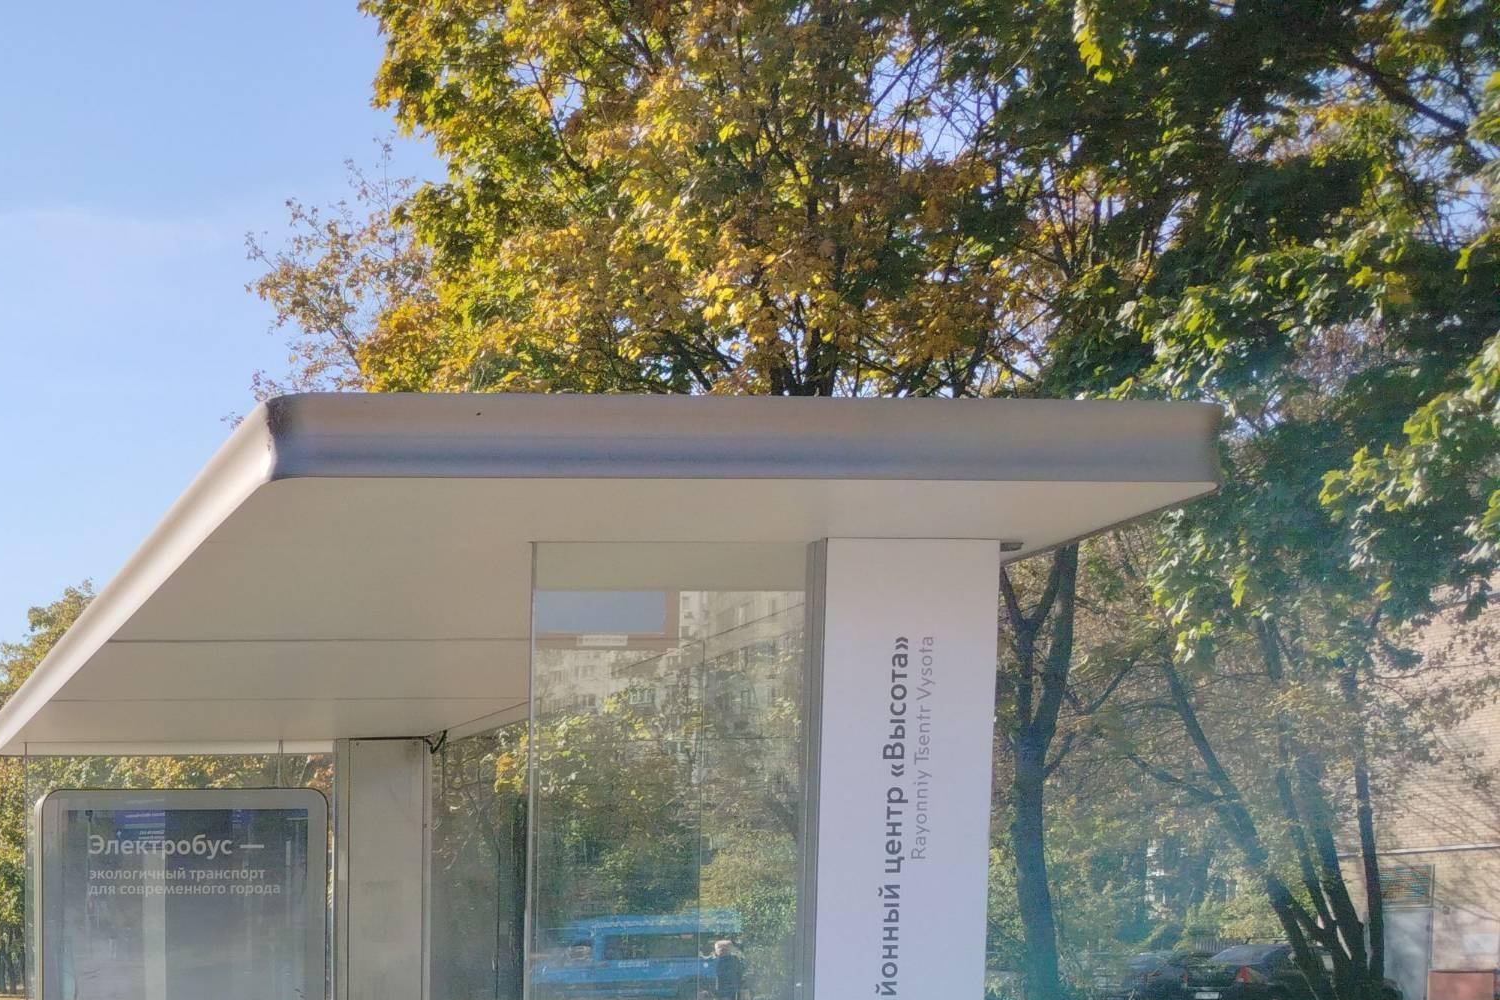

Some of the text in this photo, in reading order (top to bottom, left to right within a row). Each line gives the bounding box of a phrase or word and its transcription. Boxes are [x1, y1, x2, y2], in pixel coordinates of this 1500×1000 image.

[882, 636, 910, 778] «Высота»
[910, 635, 937, 861] Rayonniy Tsentr Vysota
[88, 834, 233, 860] Электробус
[884, 786, 910, 874] центр
[88, 867, 266, 883] экологичный транспорт
[88, 884, 281, 898] для современного города
